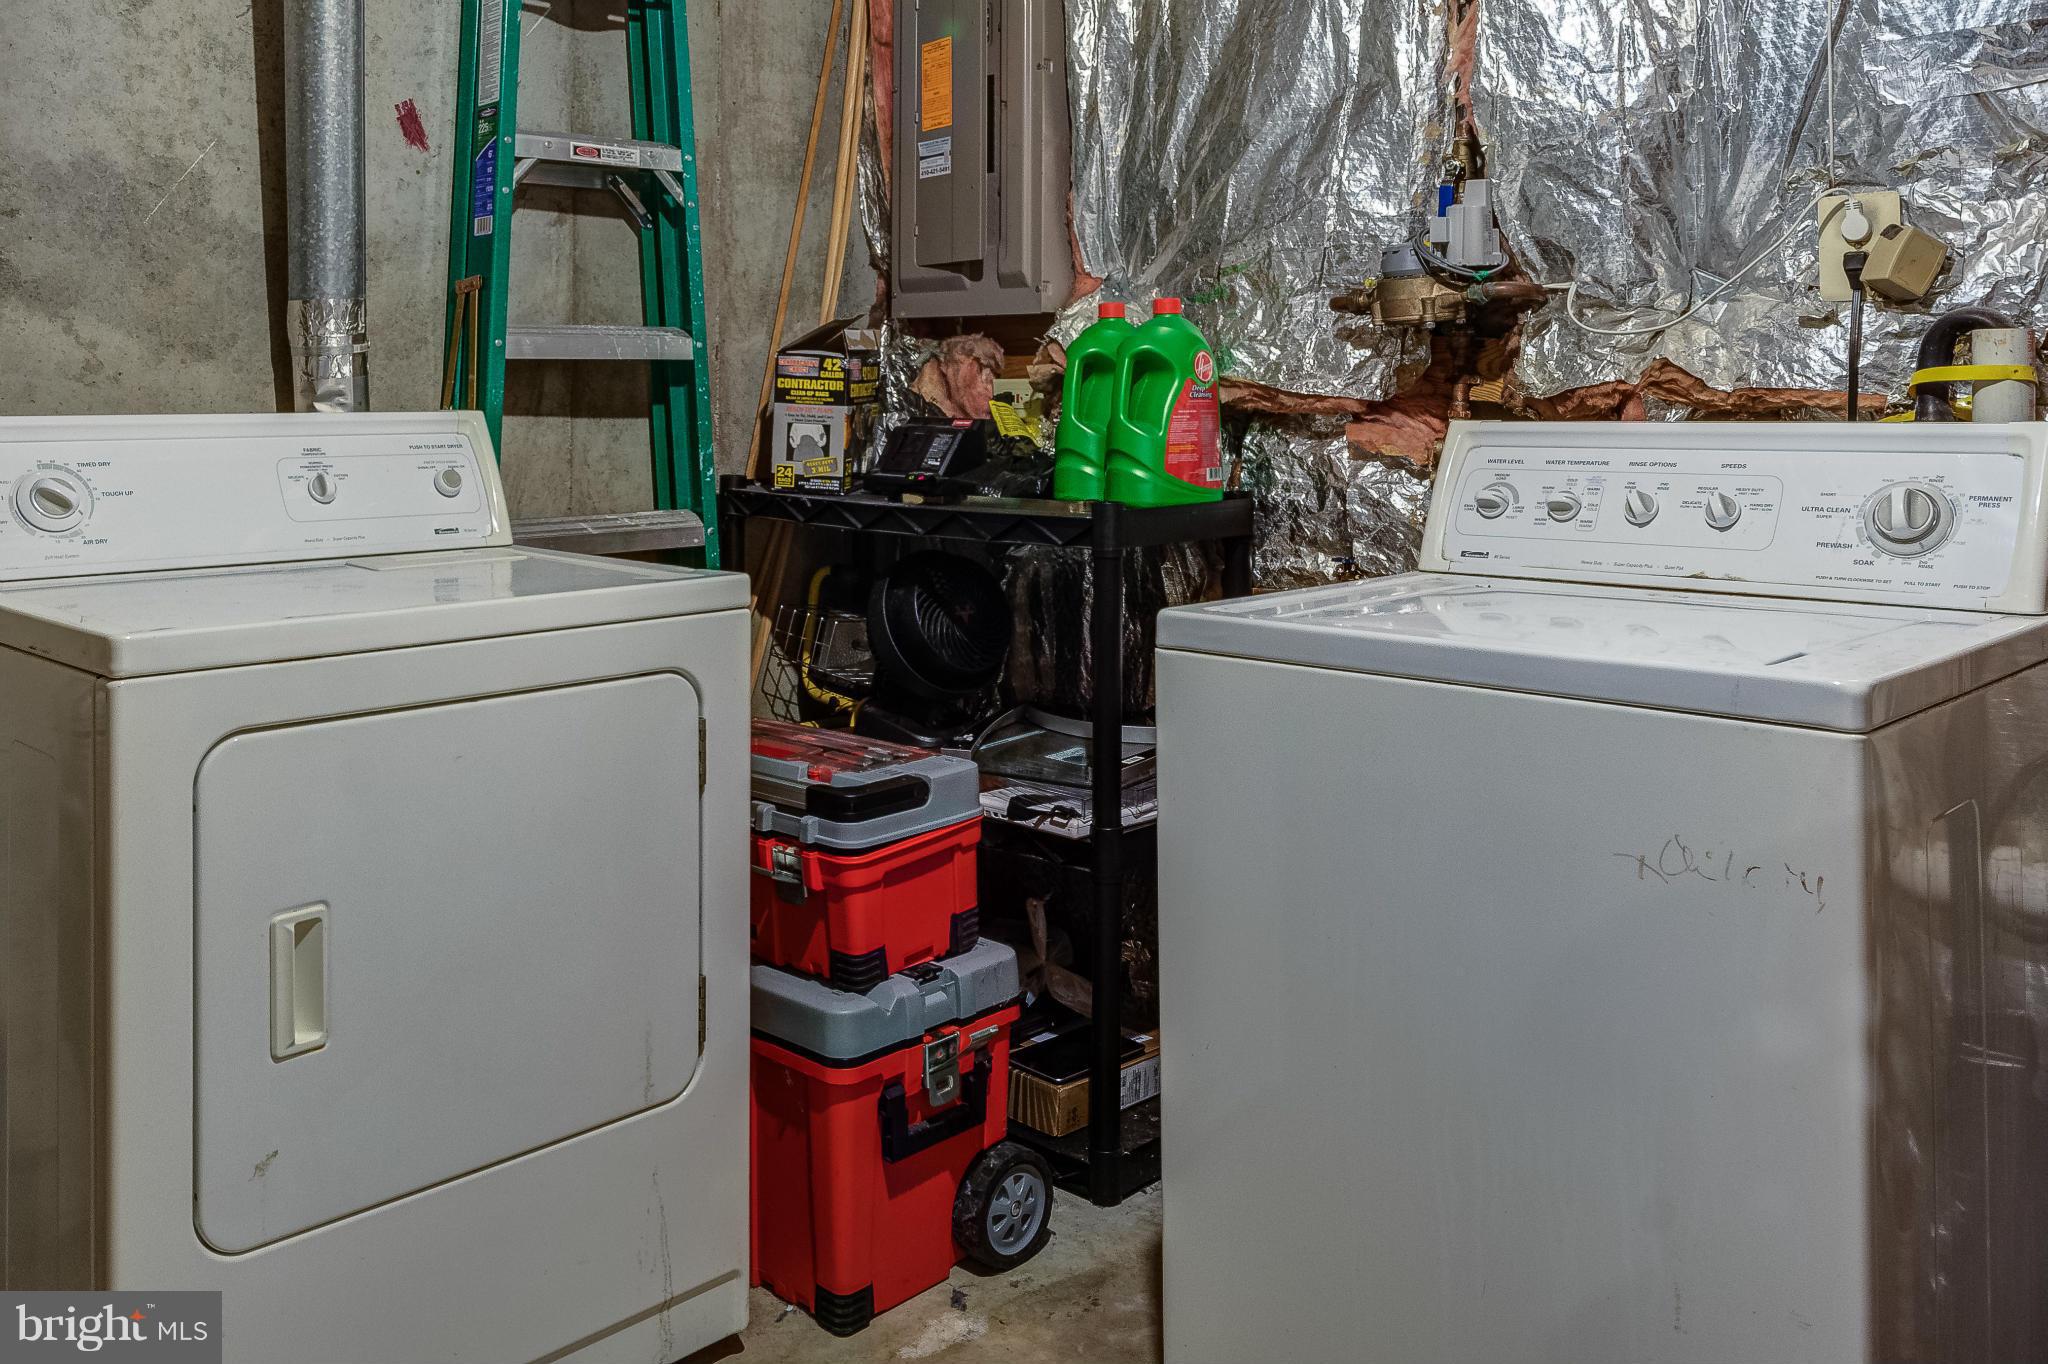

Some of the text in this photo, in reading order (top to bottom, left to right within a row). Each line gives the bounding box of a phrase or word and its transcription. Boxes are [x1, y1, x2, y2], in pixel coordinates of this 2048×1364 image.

[823, 358, 842, 371] 42
[820, 371, 845, 379] GALLON
[777, 378, 844, 391] CONTRACTOR
[1191, 384, 1206, 392] Deep
[777, 467, 793, 478] 24
[1816, 541, 1853, 549] PREWASH
